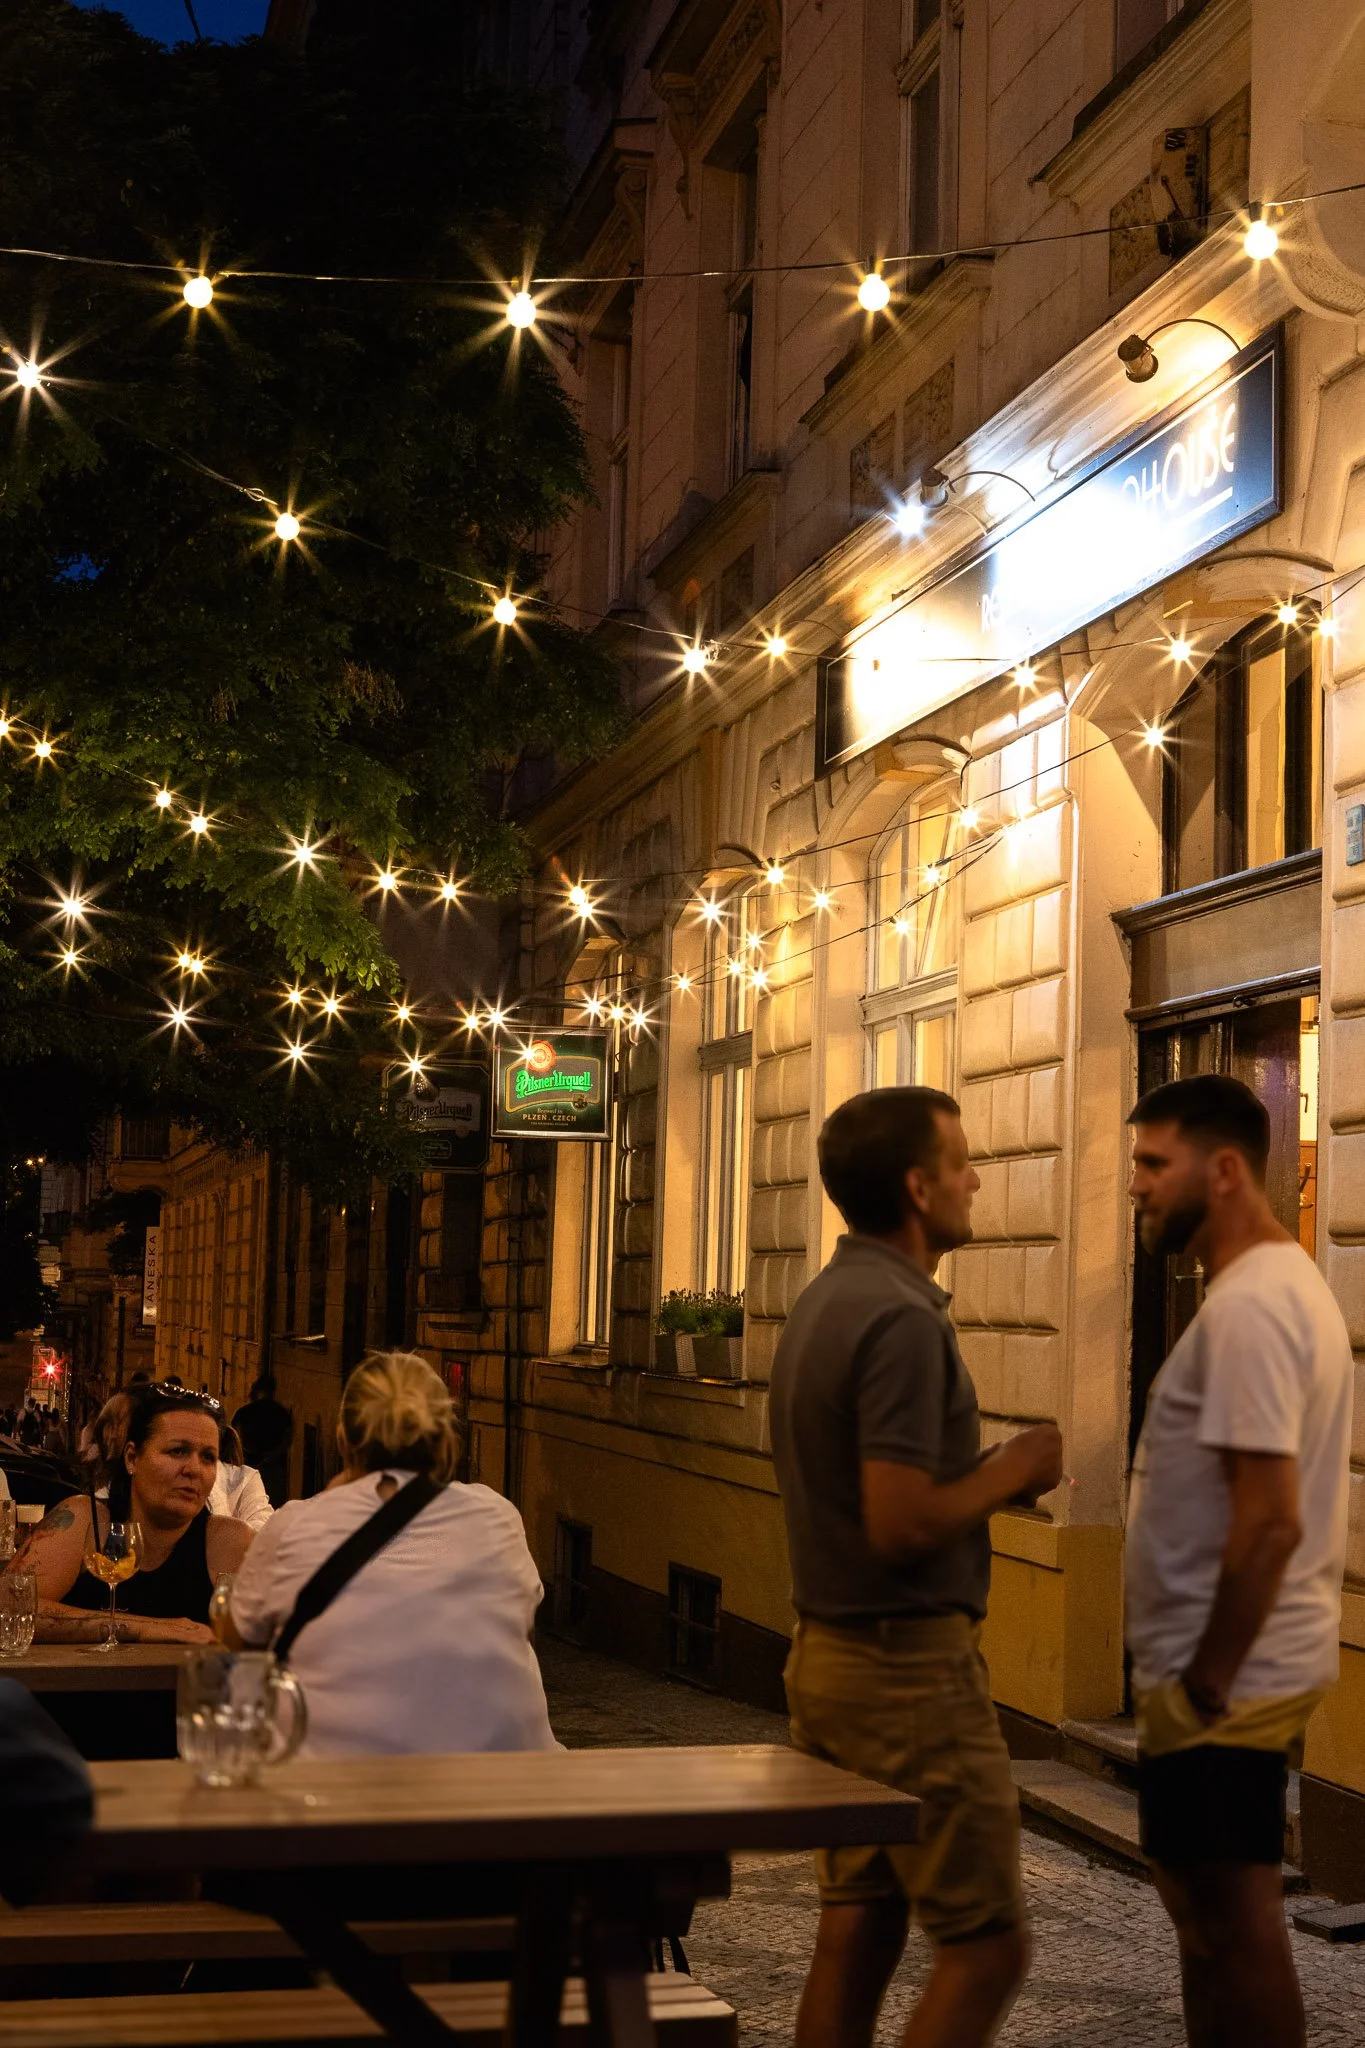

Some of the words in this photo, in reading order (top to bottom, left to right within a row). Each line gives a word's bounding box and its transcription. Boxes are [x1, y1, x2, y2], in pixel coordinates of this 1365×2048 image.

[515, 1070, 555, 1099] Pilsner
[553, 1070, 591, 1092] Urquell
[552, 1114, 577, 1122] CZECH
